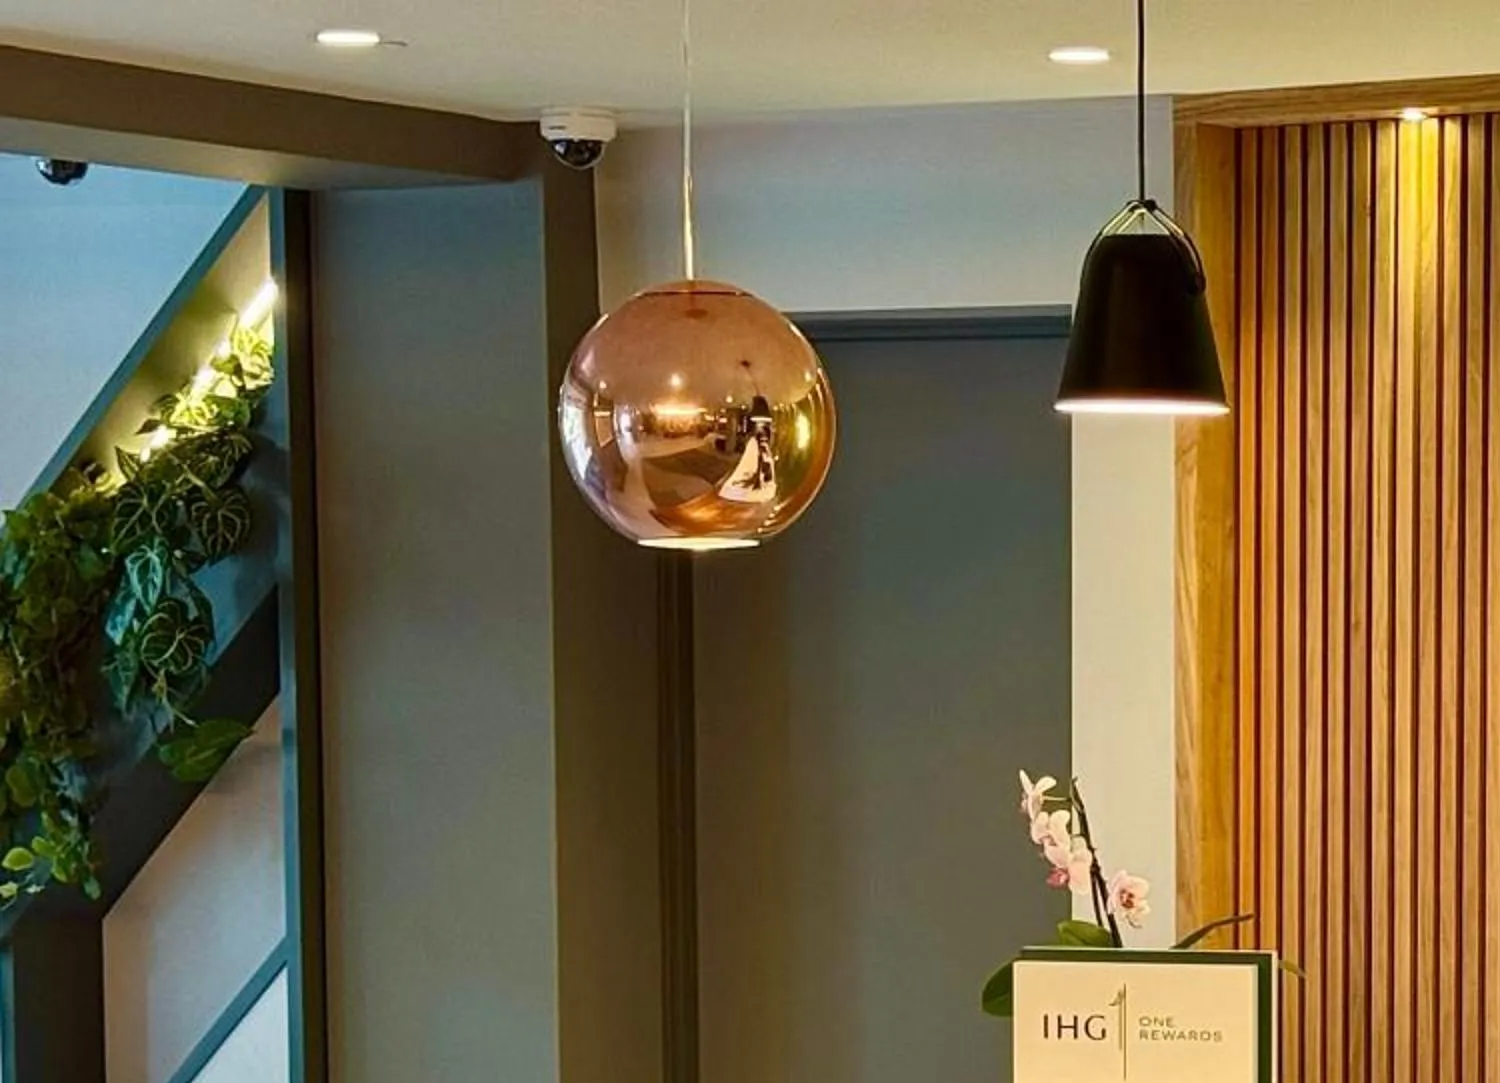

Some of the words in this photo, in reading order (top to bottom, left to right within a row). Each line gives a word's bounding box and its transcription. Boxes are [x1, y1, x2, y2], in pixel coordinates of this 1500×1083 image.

[1042, 1013, 1108, 1042] IHG
[1138, 1016, 1176, 1028] ONE
[1138, 1030, 1224, 1043] REWARDS
